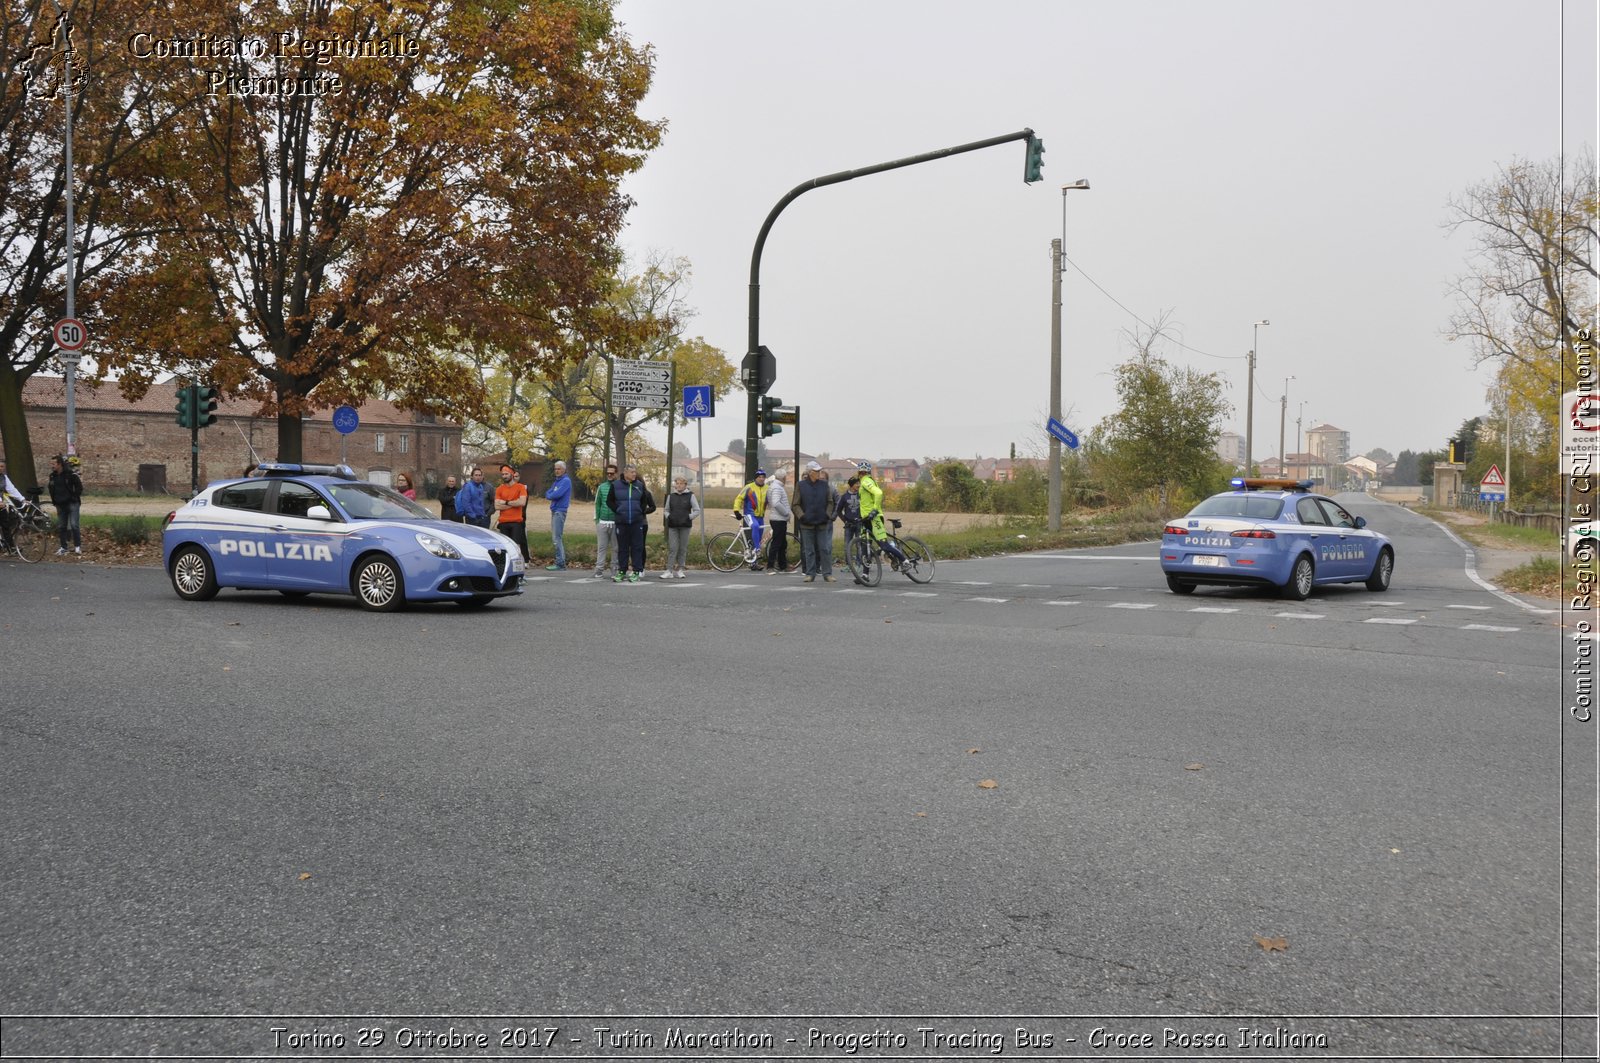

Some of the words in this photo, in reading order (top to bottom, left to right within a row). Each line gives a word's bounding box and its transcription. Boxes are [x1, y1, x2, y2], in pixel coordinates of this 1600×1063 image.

[62, 326, 79, 342] 50
[191, 498, 208, 507] 113
[1283, 513, 1297, 522] 113
[1185, 536, 1231, 546] POLIZIA
[220, 539, 333, 562] POLIZIA
[1321, 543, 1365, 561] POLIZIA
